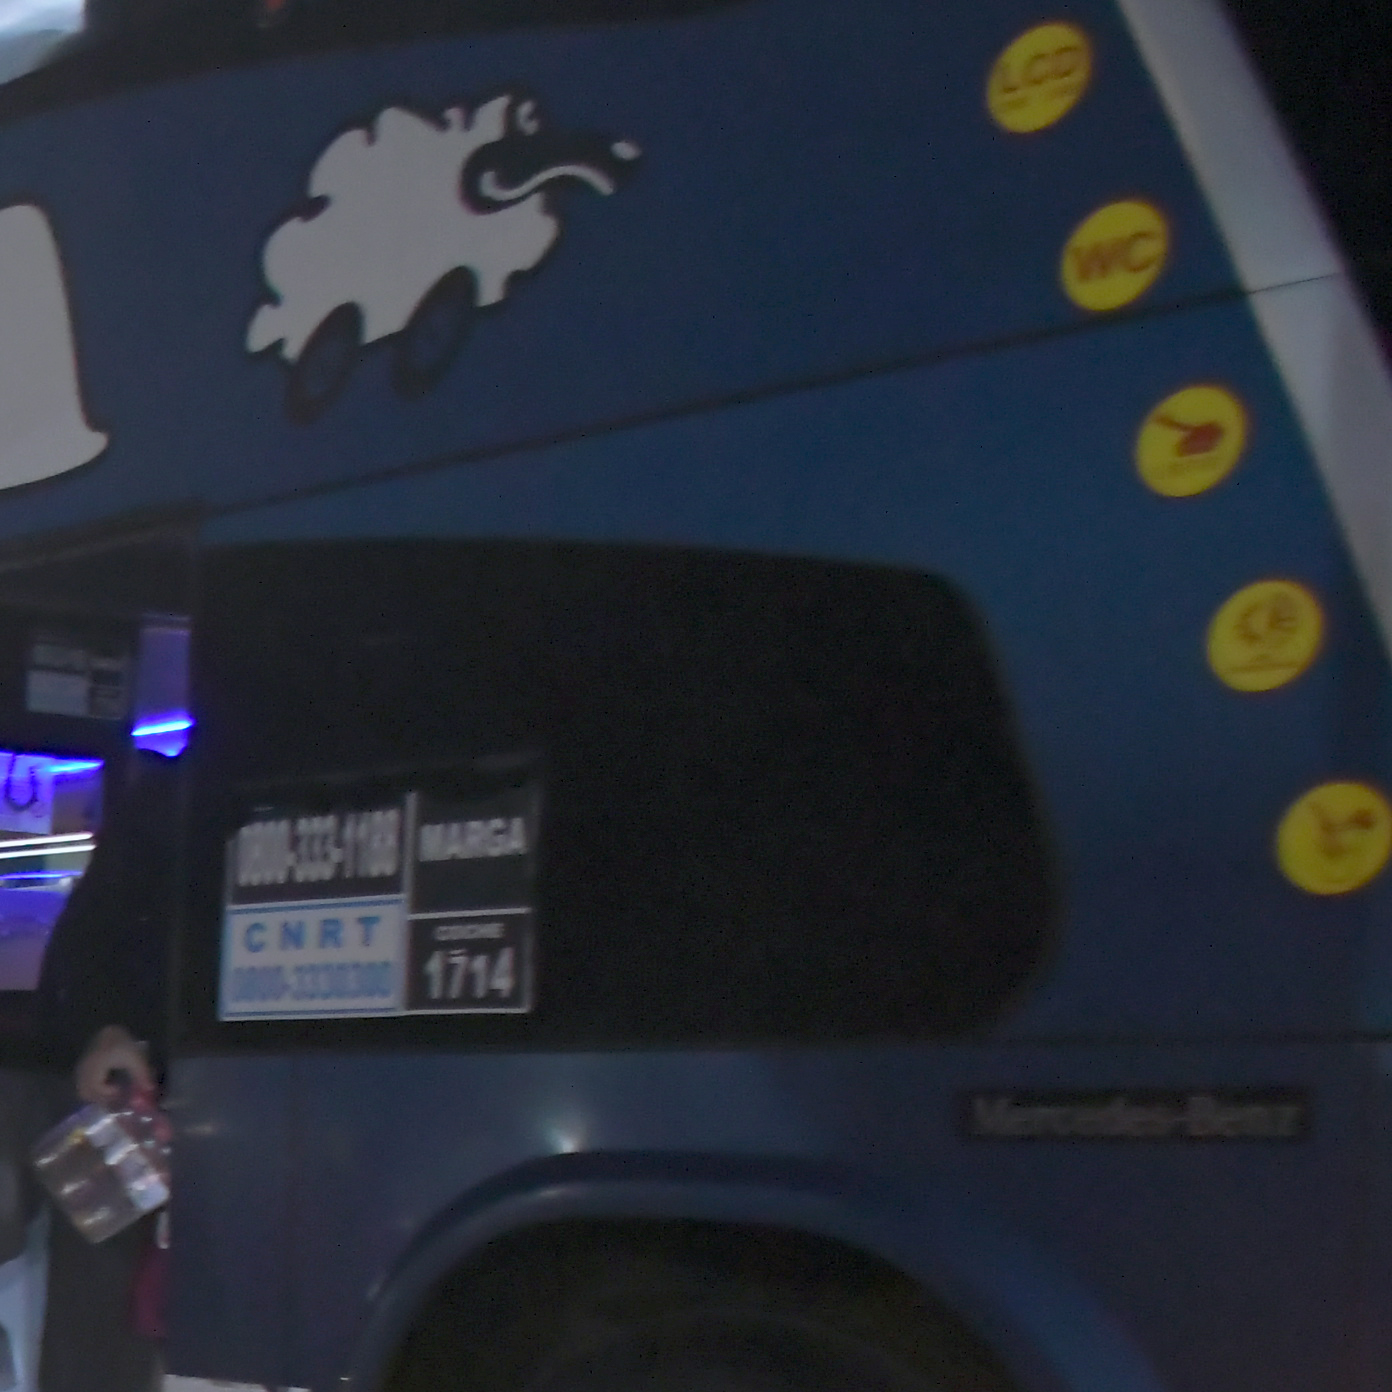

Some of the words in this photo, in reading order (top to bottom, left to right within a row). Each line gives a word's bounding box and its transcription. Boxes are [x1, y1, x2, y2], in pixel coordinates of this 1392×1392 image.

[1071, 230, 1162, 283] WC
[418, 816, 528, 862] MARGA
[423, 946, 517, 1001] 1714
